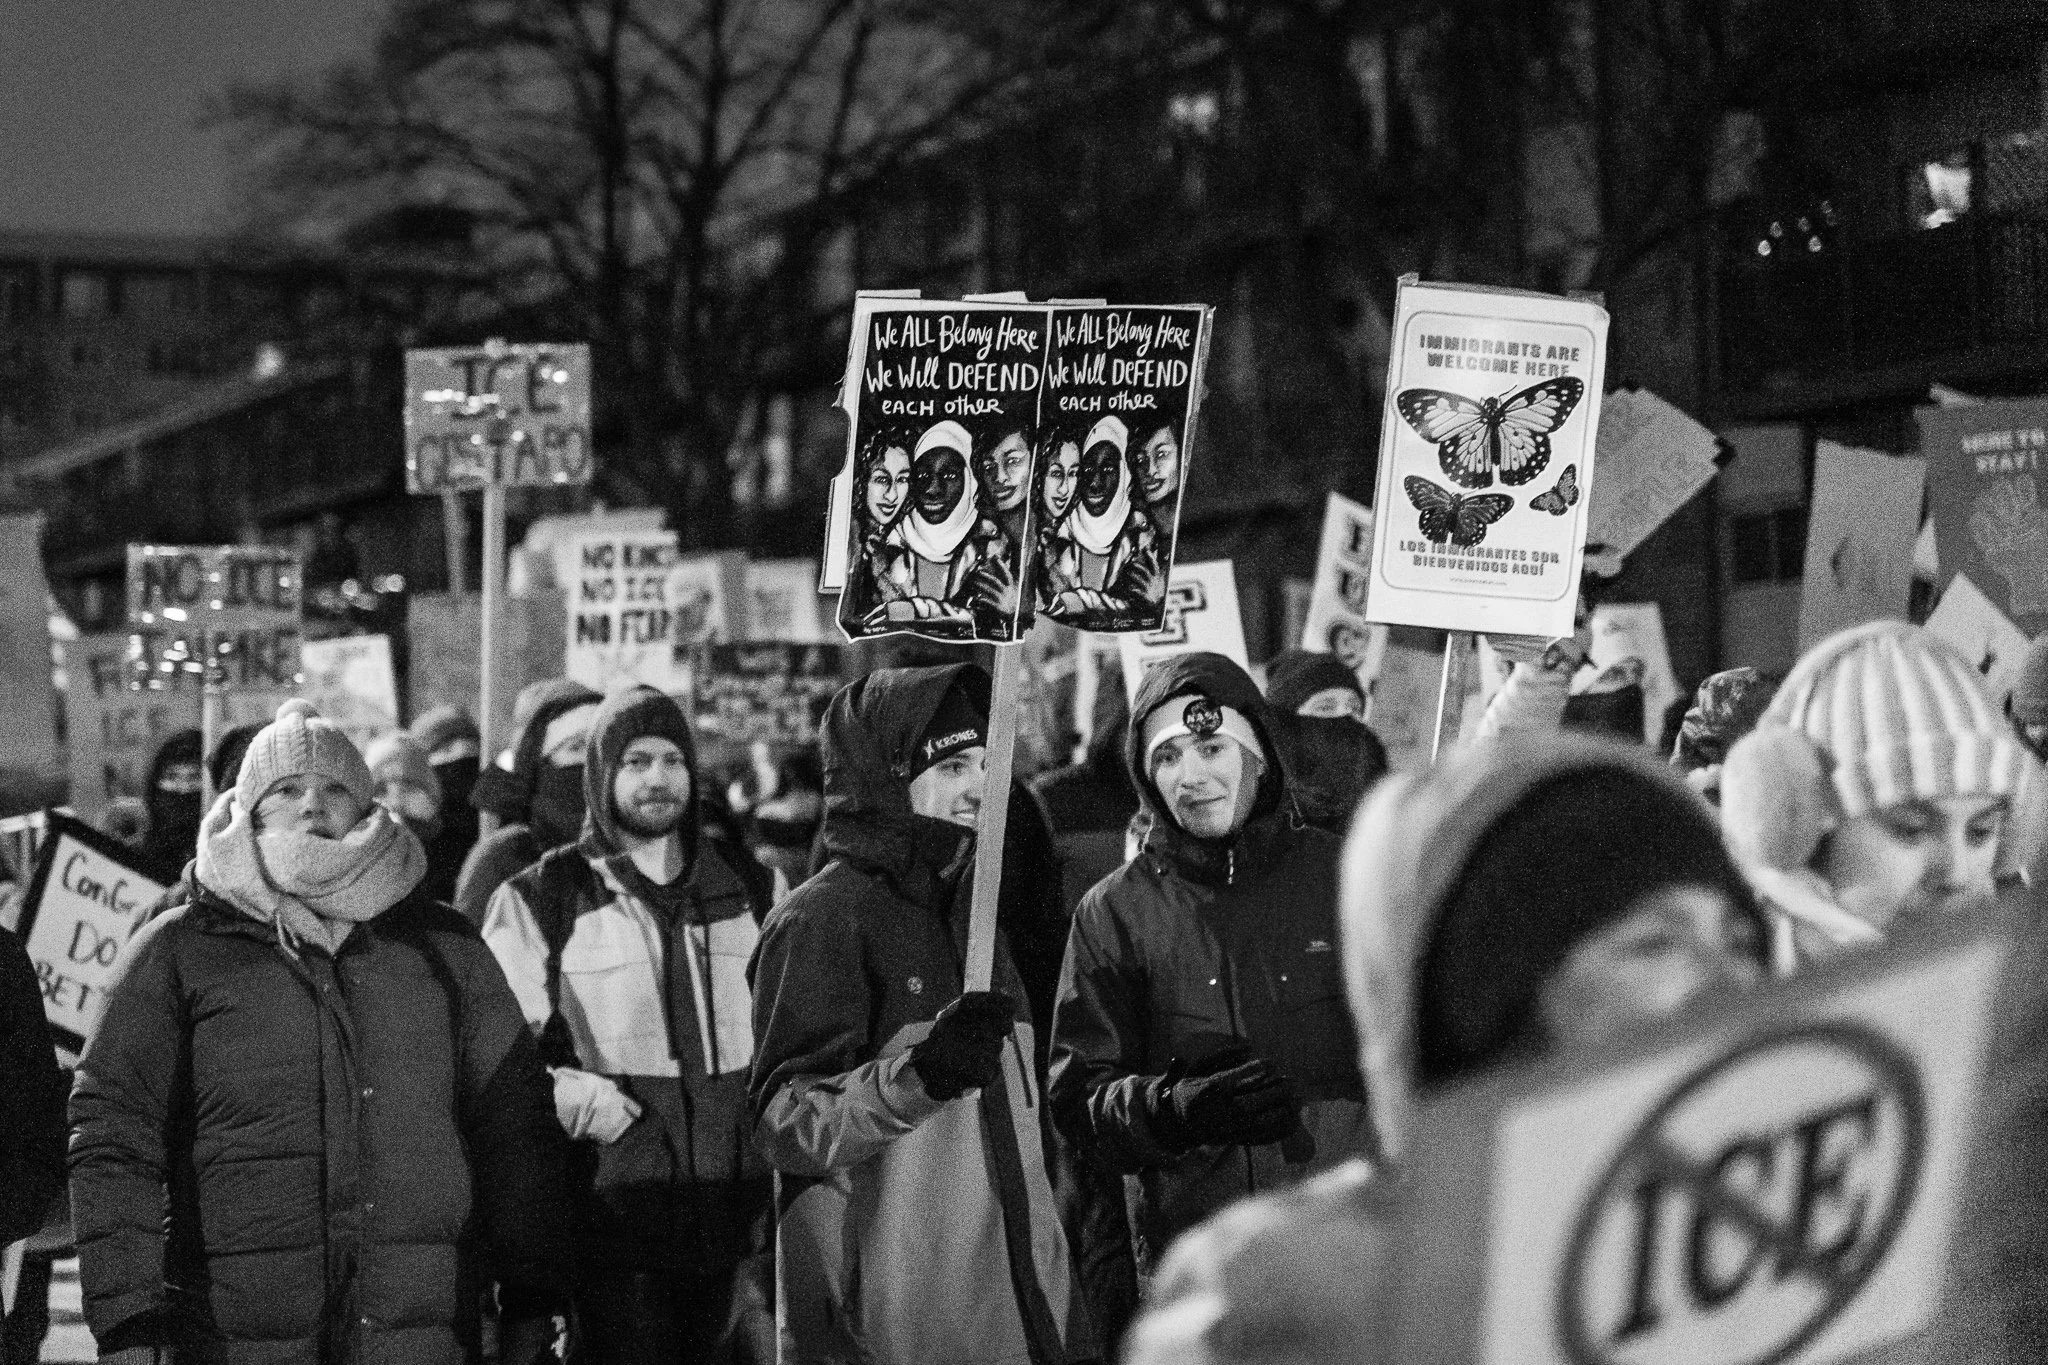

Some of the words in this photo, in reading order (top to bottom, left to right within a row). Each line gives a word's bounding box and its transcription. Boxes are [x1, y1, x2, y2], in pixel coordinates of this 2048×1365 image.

[875, 317, 899, 351] We
[901, 314, 935, 348] ALL
[1056, 315, 1076, 349] We
[1076, 312, 1105, 345] ALL
[1419, 334, 1542, 359] IMMIGRANTS
[1546, 344, 1580, 362] ARE
[866, 359, 893, 393] We
[897, 355, 941, 390] Will
[1048, 356, 1070, 389] We
[1073, 352, 1107, 386] Will
[1427, 352, 1519, 375] WELCOME
[1525, 361, 1570, 377] HERE
[583, 544, 614, 569] NO
[1399, 540, 1427, 553] LOS
[1531, 550, 1560, 564] SON
[1412, 554, 1509, 574] BIENVENIDOS
[1511, 562, 1545, 576] AQUÍ
[143, 554, 202, 608] NO
[582, 577, 615, 602] NO
[935, 729, 978, 749] KRONES
[68, 919, 118, 967] Do
